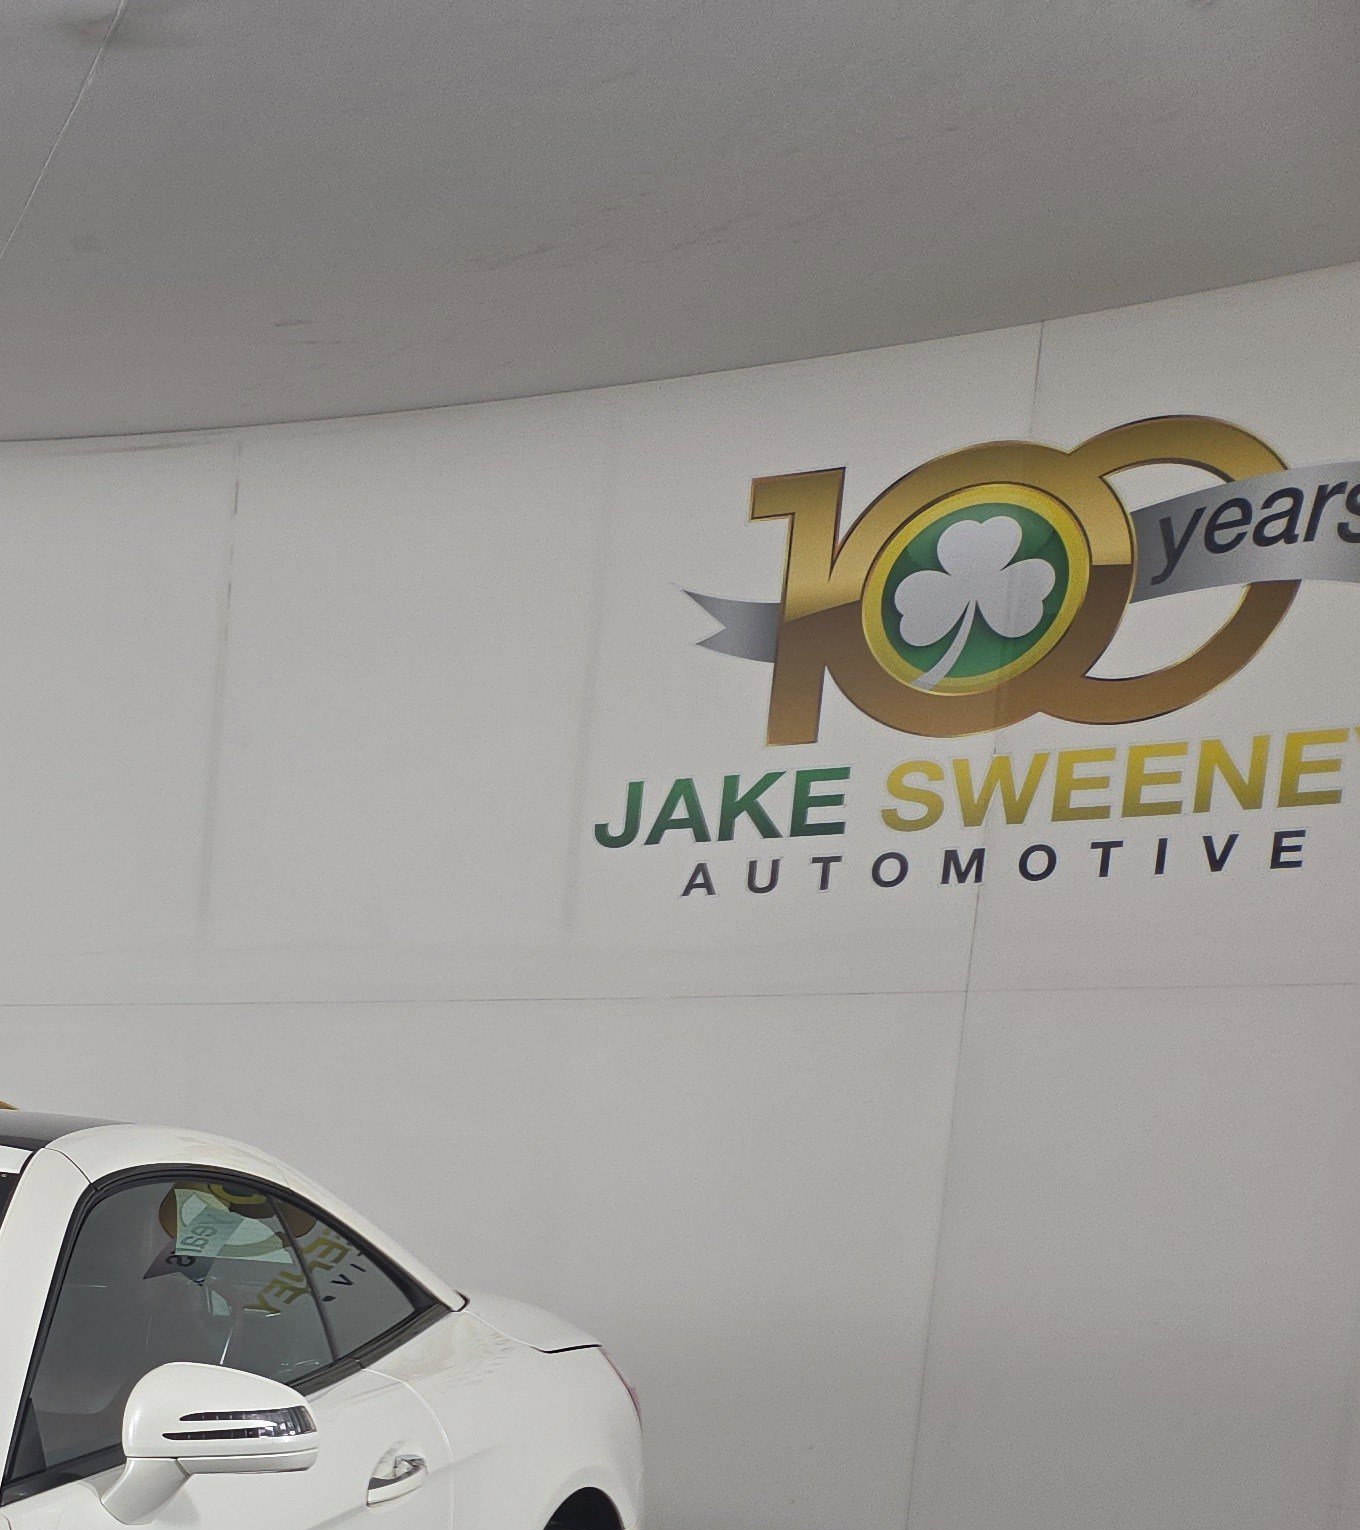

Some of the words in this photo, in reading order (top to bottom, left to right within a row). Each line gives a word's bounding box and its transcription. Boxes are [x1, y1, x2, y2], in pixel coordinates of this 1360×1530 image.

[594, 767, 851, 849] JAKE
[880, 725, 1360, 832] SWEENE
[681, 829, 1307, 898] AUTOMOTIVE
